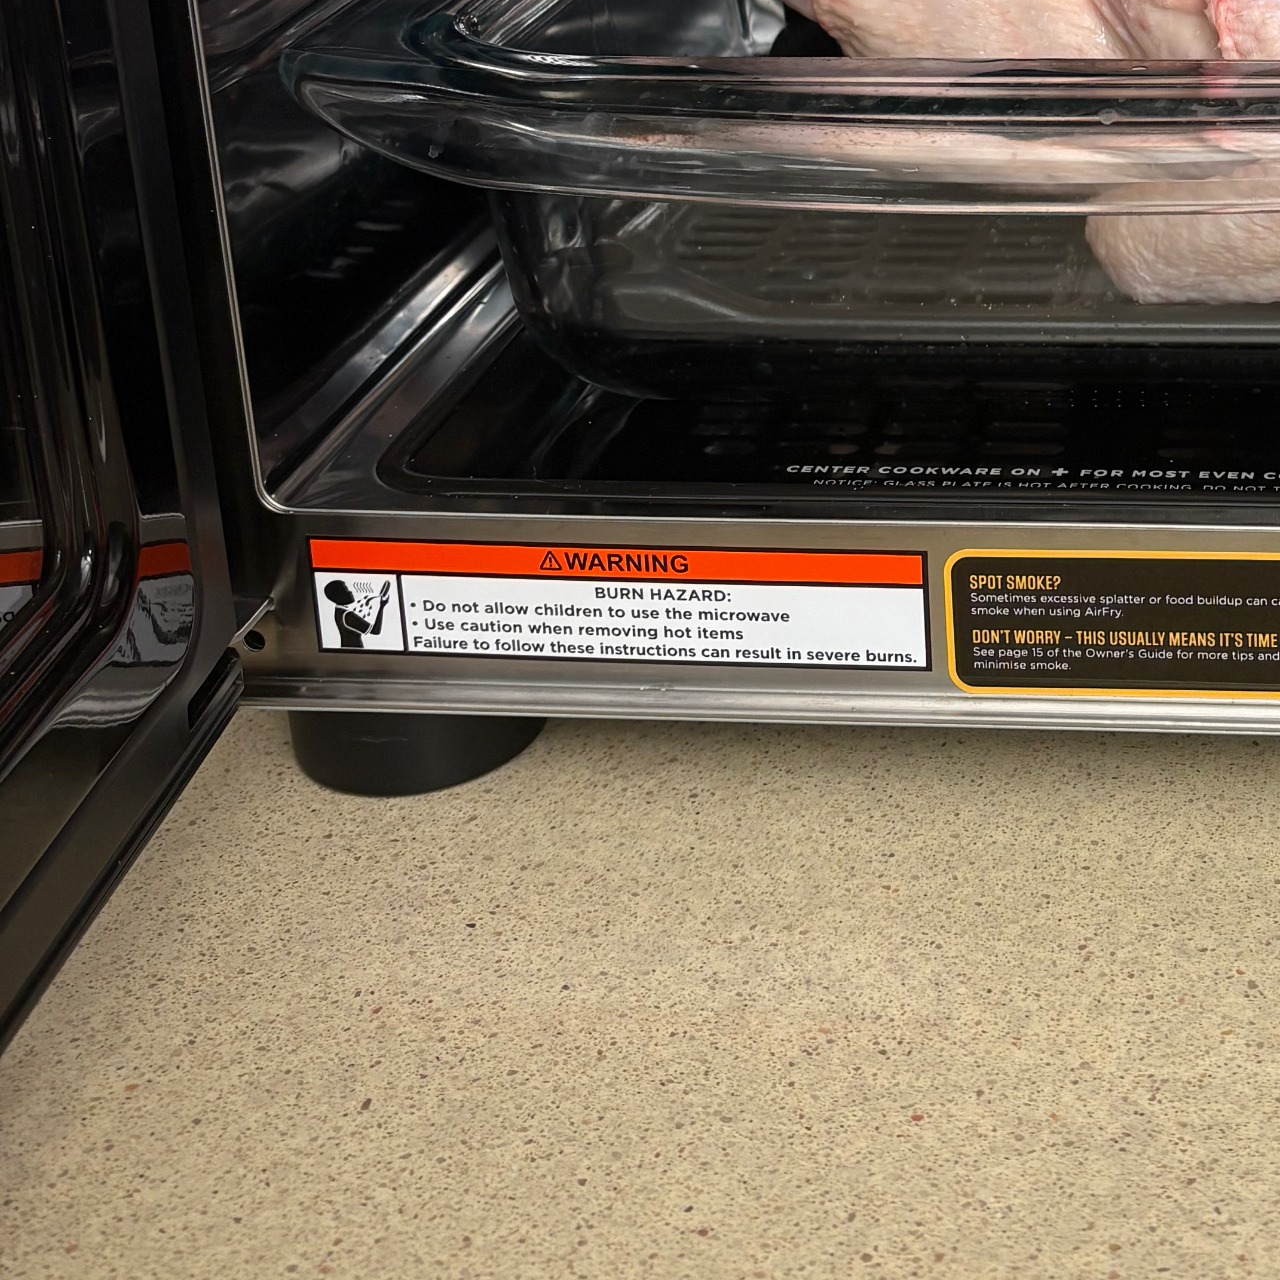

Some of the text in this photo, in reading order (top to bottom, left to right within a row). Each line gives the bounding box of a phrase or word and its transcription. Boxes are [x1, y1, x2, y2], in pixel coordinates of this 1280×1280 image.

[786, 465, 870, 473] CENTER
[878, 466, 1001, 475] COOKWARE
[1010, 467, 1040, 476] ON
[1080, 469, 1123, 478] FOR
[1131, 469, 1190, 478] MOST
[1198, 471, 1254, 479] EVEN
[564, 552, 688, 573] WARNING
[969, 574, 1061, 590] SPOT SMOKE?
[594, 586, 731, 602] BURN HAZARD:
[422, 599, 790, 622] Do not allow children to use the microwave
[424, 617, 743, 640] Use caution when removing hot items
[972, 629, 1010, 643] DON'T
[1013, 629, 1060, 644] WORRY
[1075, 630, 1105, 645] THIS
[1109, 631, 1165, 646] USUALLY
[1168, 631, 1215, 646] MEANS
[1219, 632, 1243, 647] IT'S
[1246, 632, 1277, 647] TIME
[413, 635, 917, 663] Failure to follow these instructions can result in severe burns.
[973, 659, 1071, 670] minimise smoke.
